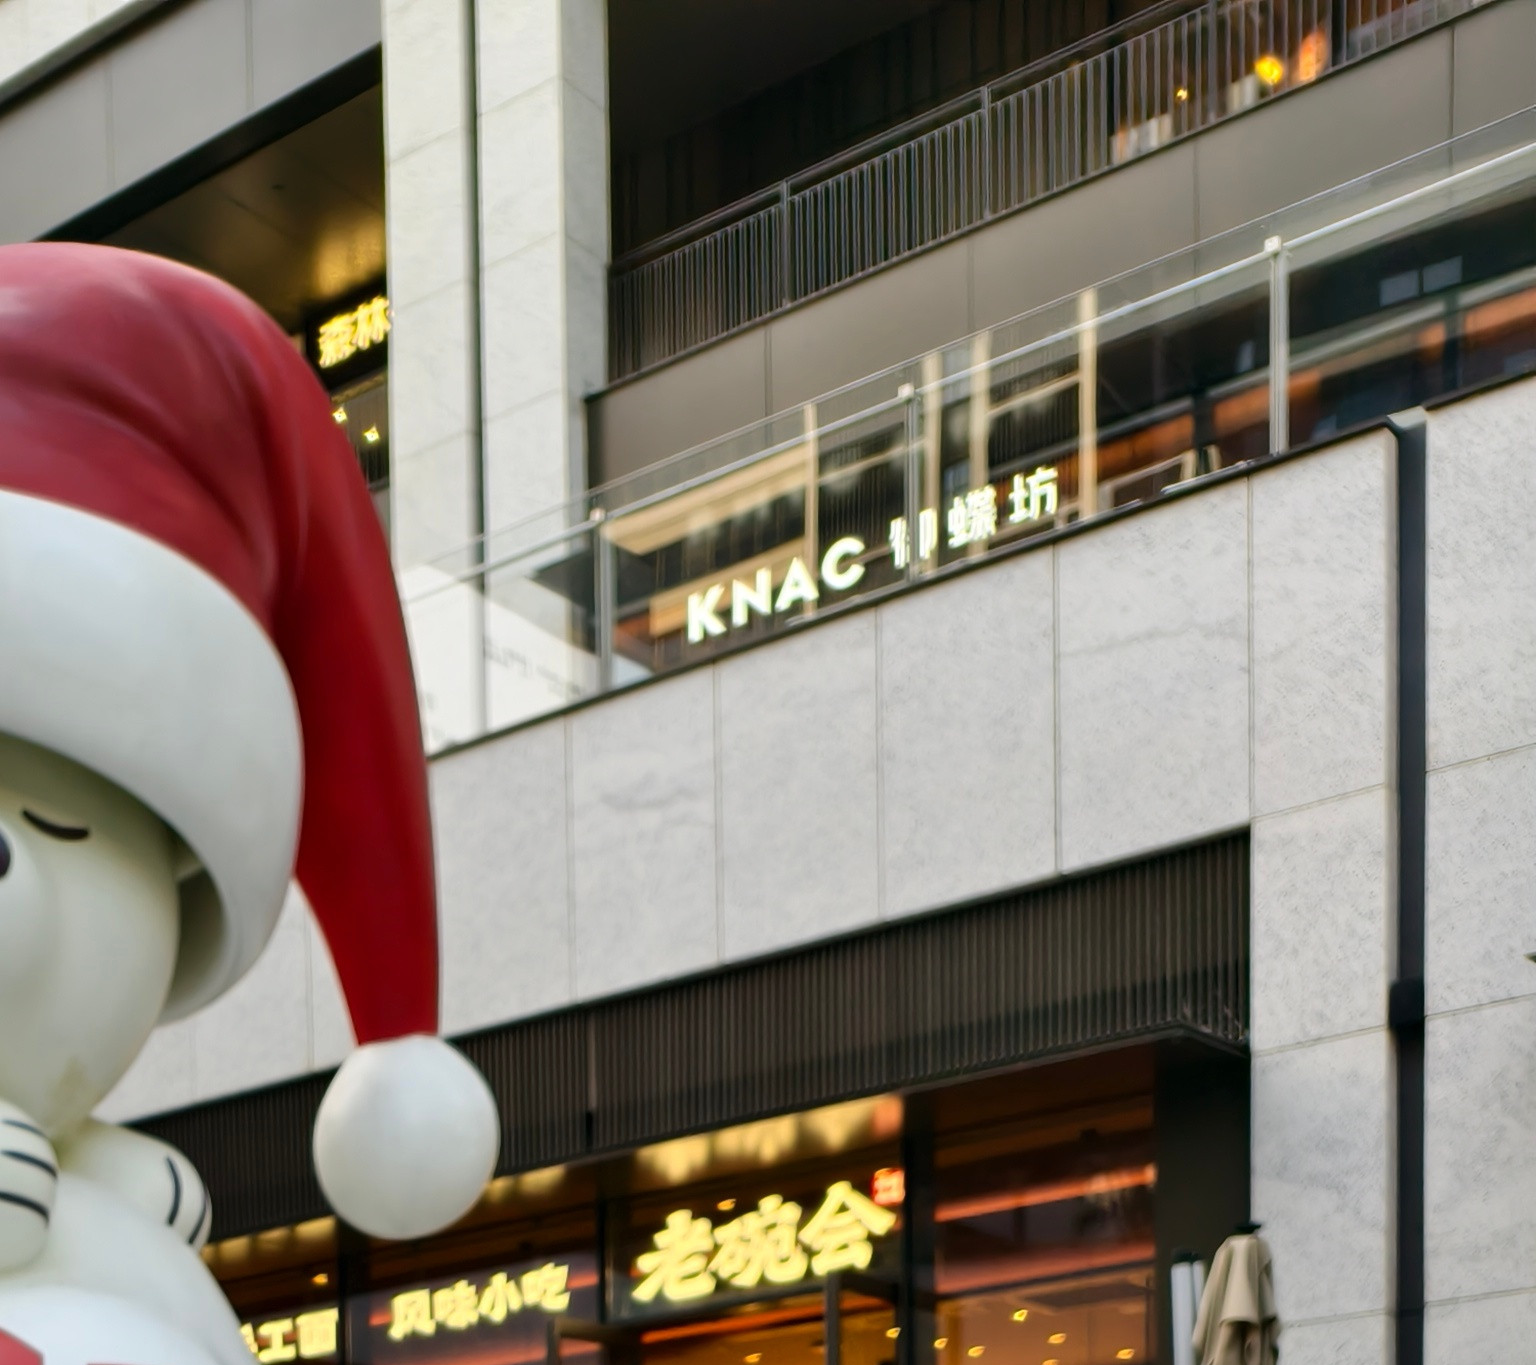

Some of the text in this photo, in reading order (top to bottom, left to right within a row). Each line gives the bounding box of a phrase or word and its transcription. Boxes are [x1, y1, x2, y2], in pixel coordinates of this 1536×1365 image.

[686, 535, 866, 646] KNAC
[630, 1180, 897, 1303] 老碗会
[387, 1262, 570, 1342] 风味小吃
